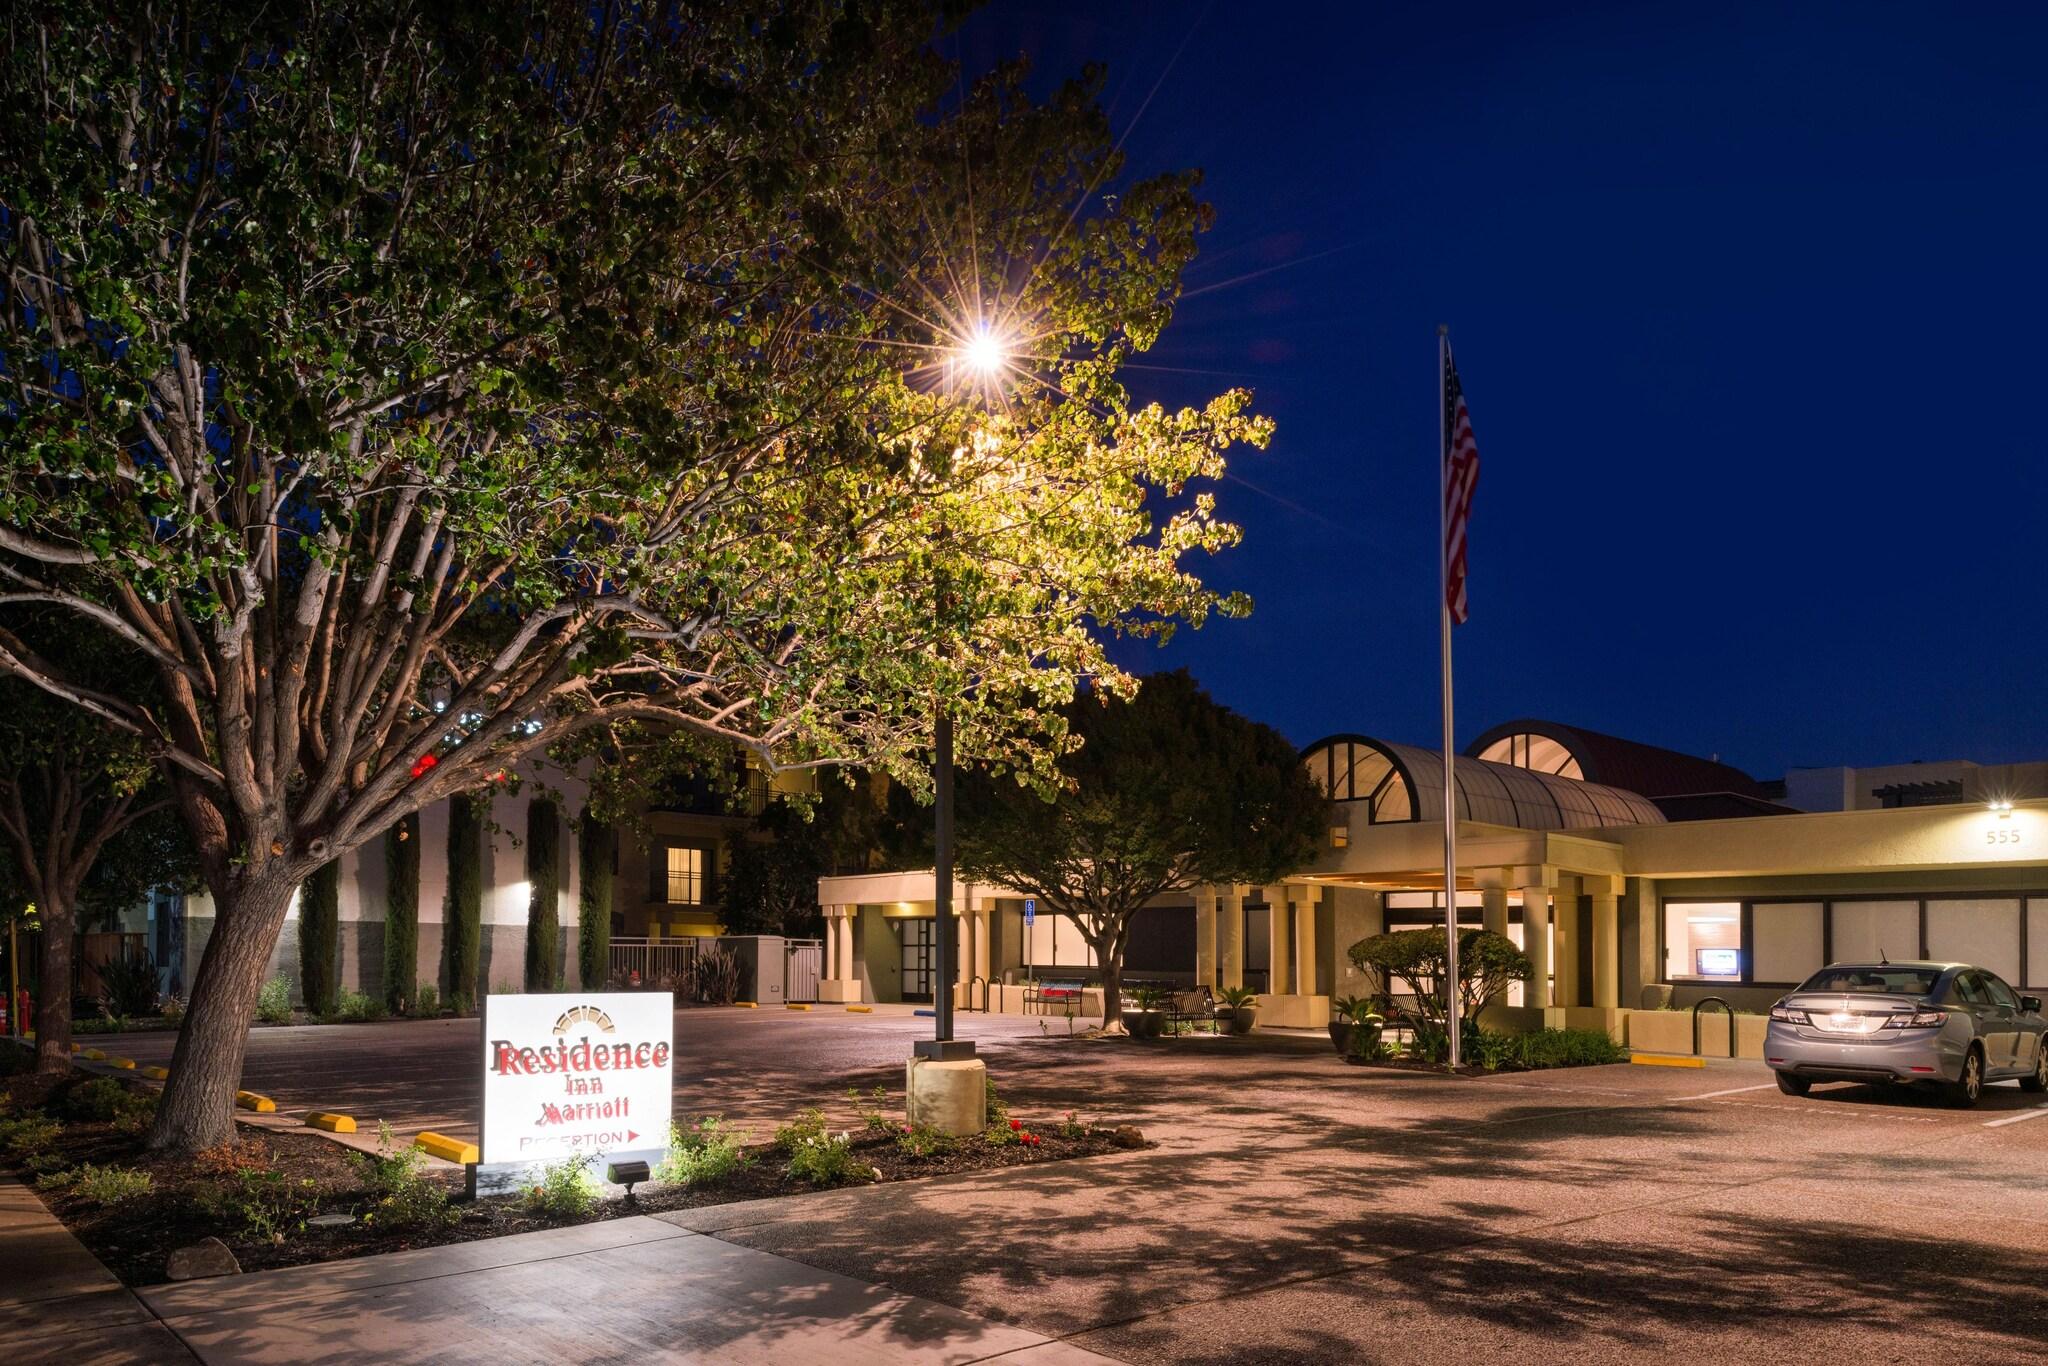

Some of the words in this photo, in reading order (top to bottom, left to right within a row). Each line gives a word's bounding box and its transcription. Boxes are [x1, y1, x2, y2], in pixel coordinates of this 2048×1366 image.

[1986, 829, 2021, 845] 555
[490, 1036, 670, 1076] Residence
[564, 1074, 604, 1096] Inn
[534, 1096, 630, 1127] Marriott
